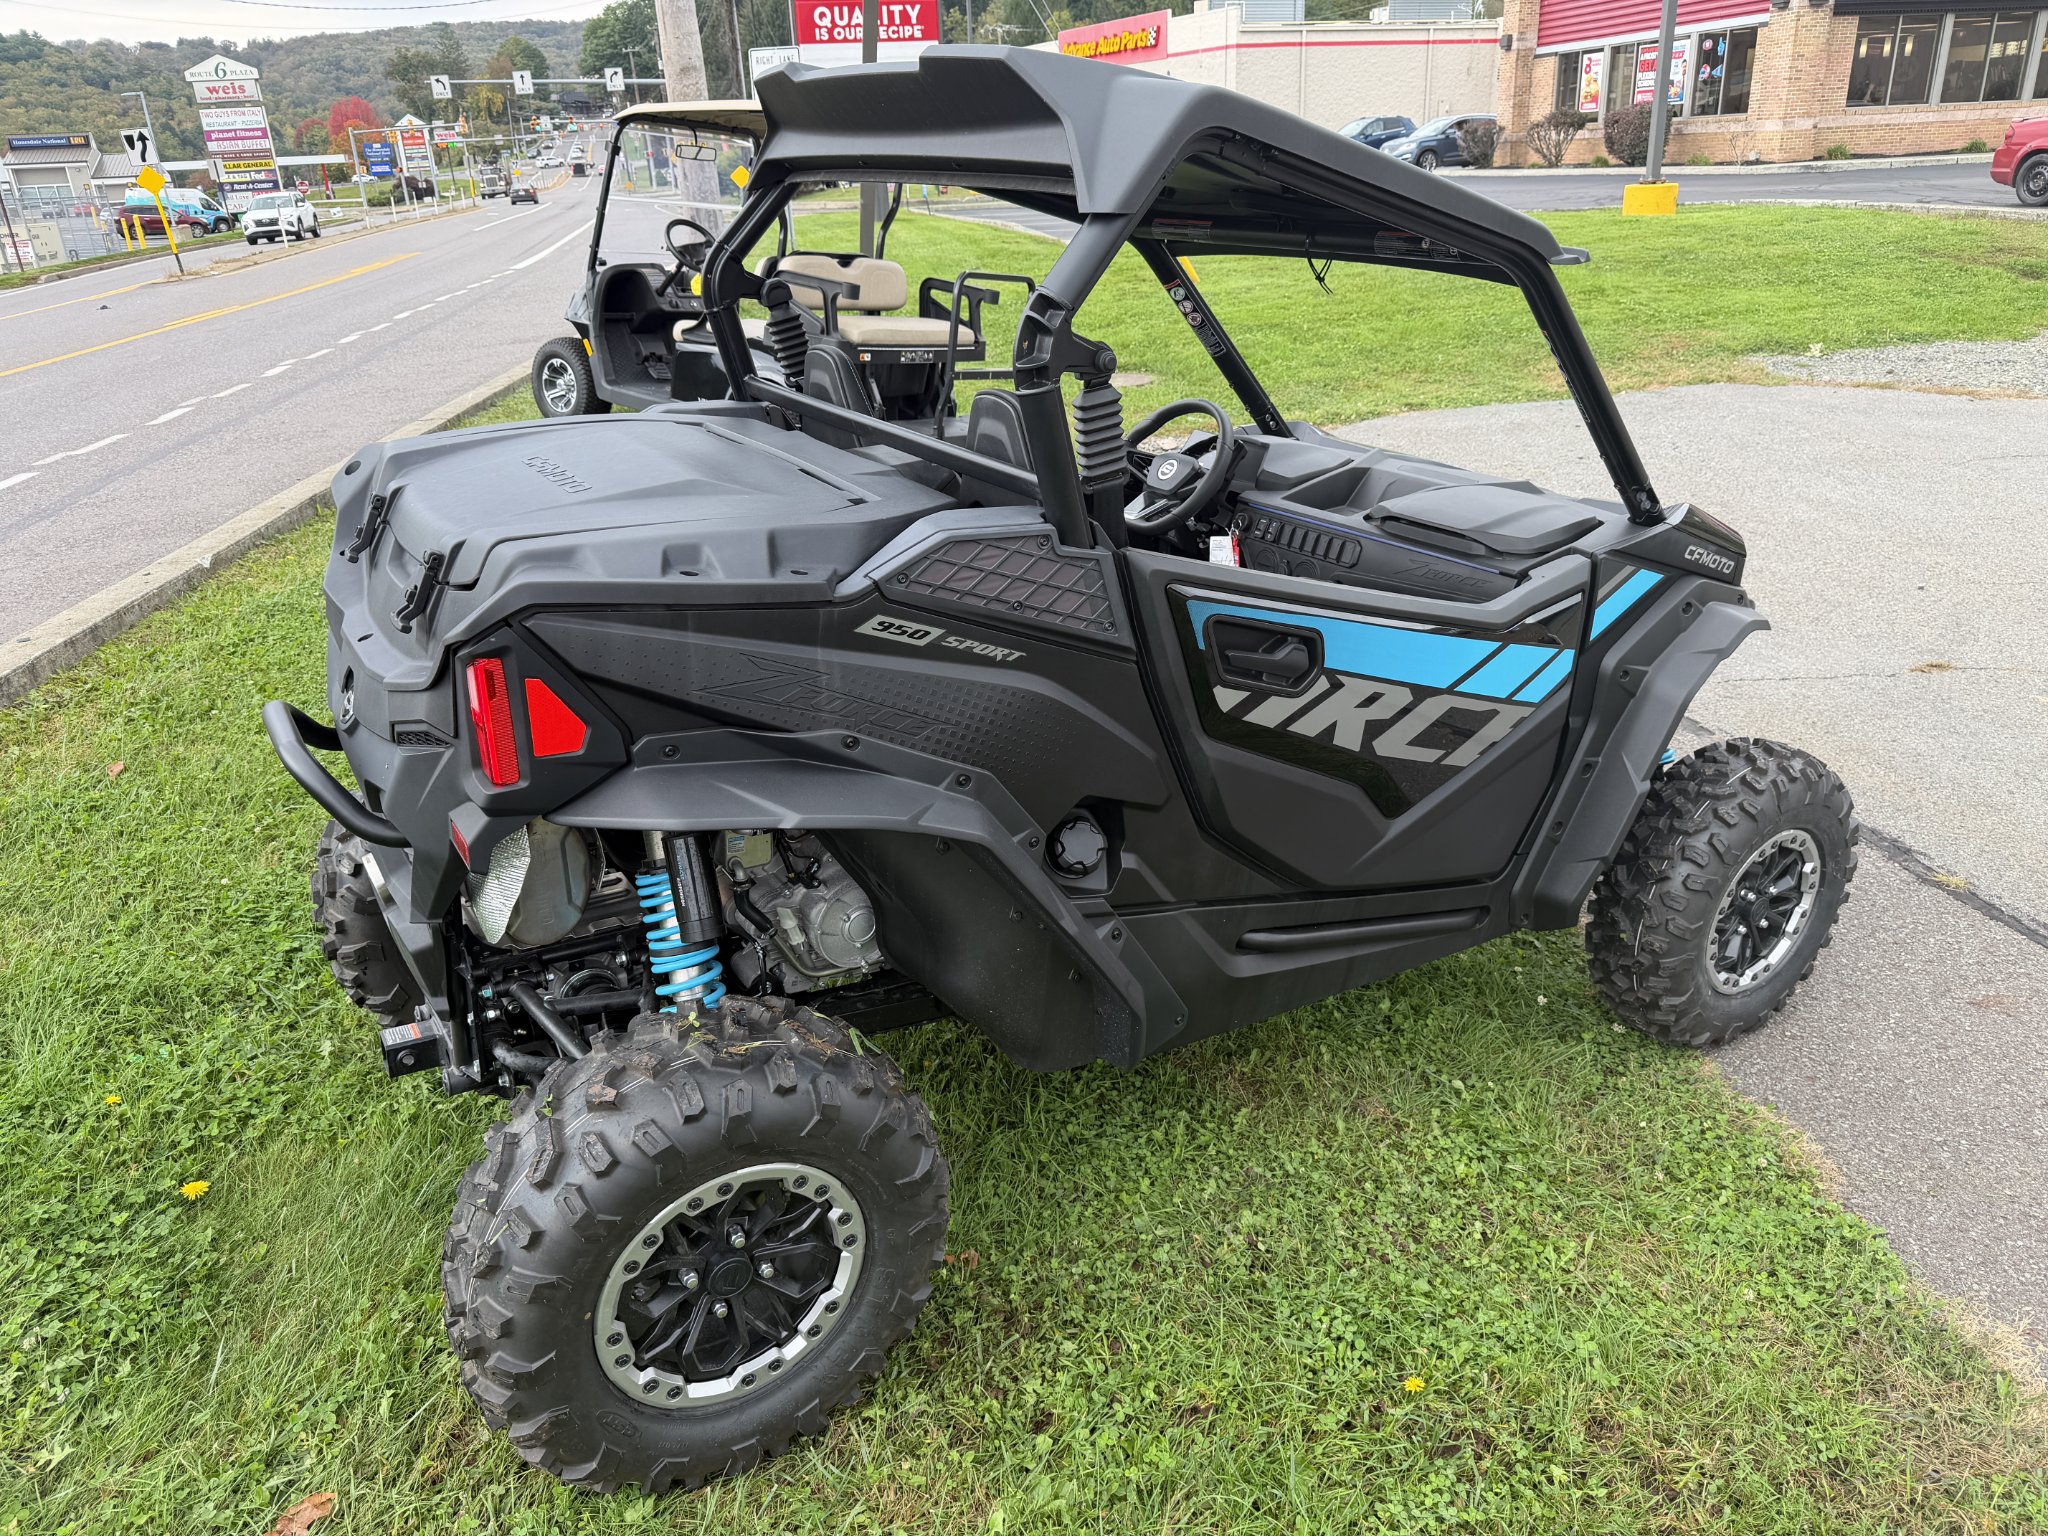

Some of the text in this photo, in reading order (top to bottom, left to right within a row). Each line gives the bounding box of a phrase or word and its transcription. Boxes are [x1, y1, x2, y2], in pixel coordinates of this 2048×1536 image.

[813, 4, 921, 28] QUAITY
[815, 28, 829, 41] IS
[877, 25, 922, 39] ECIPE
[1063, 31, 1148, 57] Advance Auto Parts
[755, 56, 774, 65] RIGHT
[214, 61, 227, 79] 6
[205, 82, 246, 95] weis
[205, 120, 237, 128] RESTAURANT
[210, 129, 262, 140] planet fitness
[216, 140, 267, 149] ASIAN BUFFET
[250, 171, 273, 180] FedEx
[233, 182, 274, 190] Rent-A-Center
[521, 456, 593, 494] CFMOTO
[1684, 545, 1735, 574] CFMOTO
[870, 619, 1028, 662] 950 SPORT
